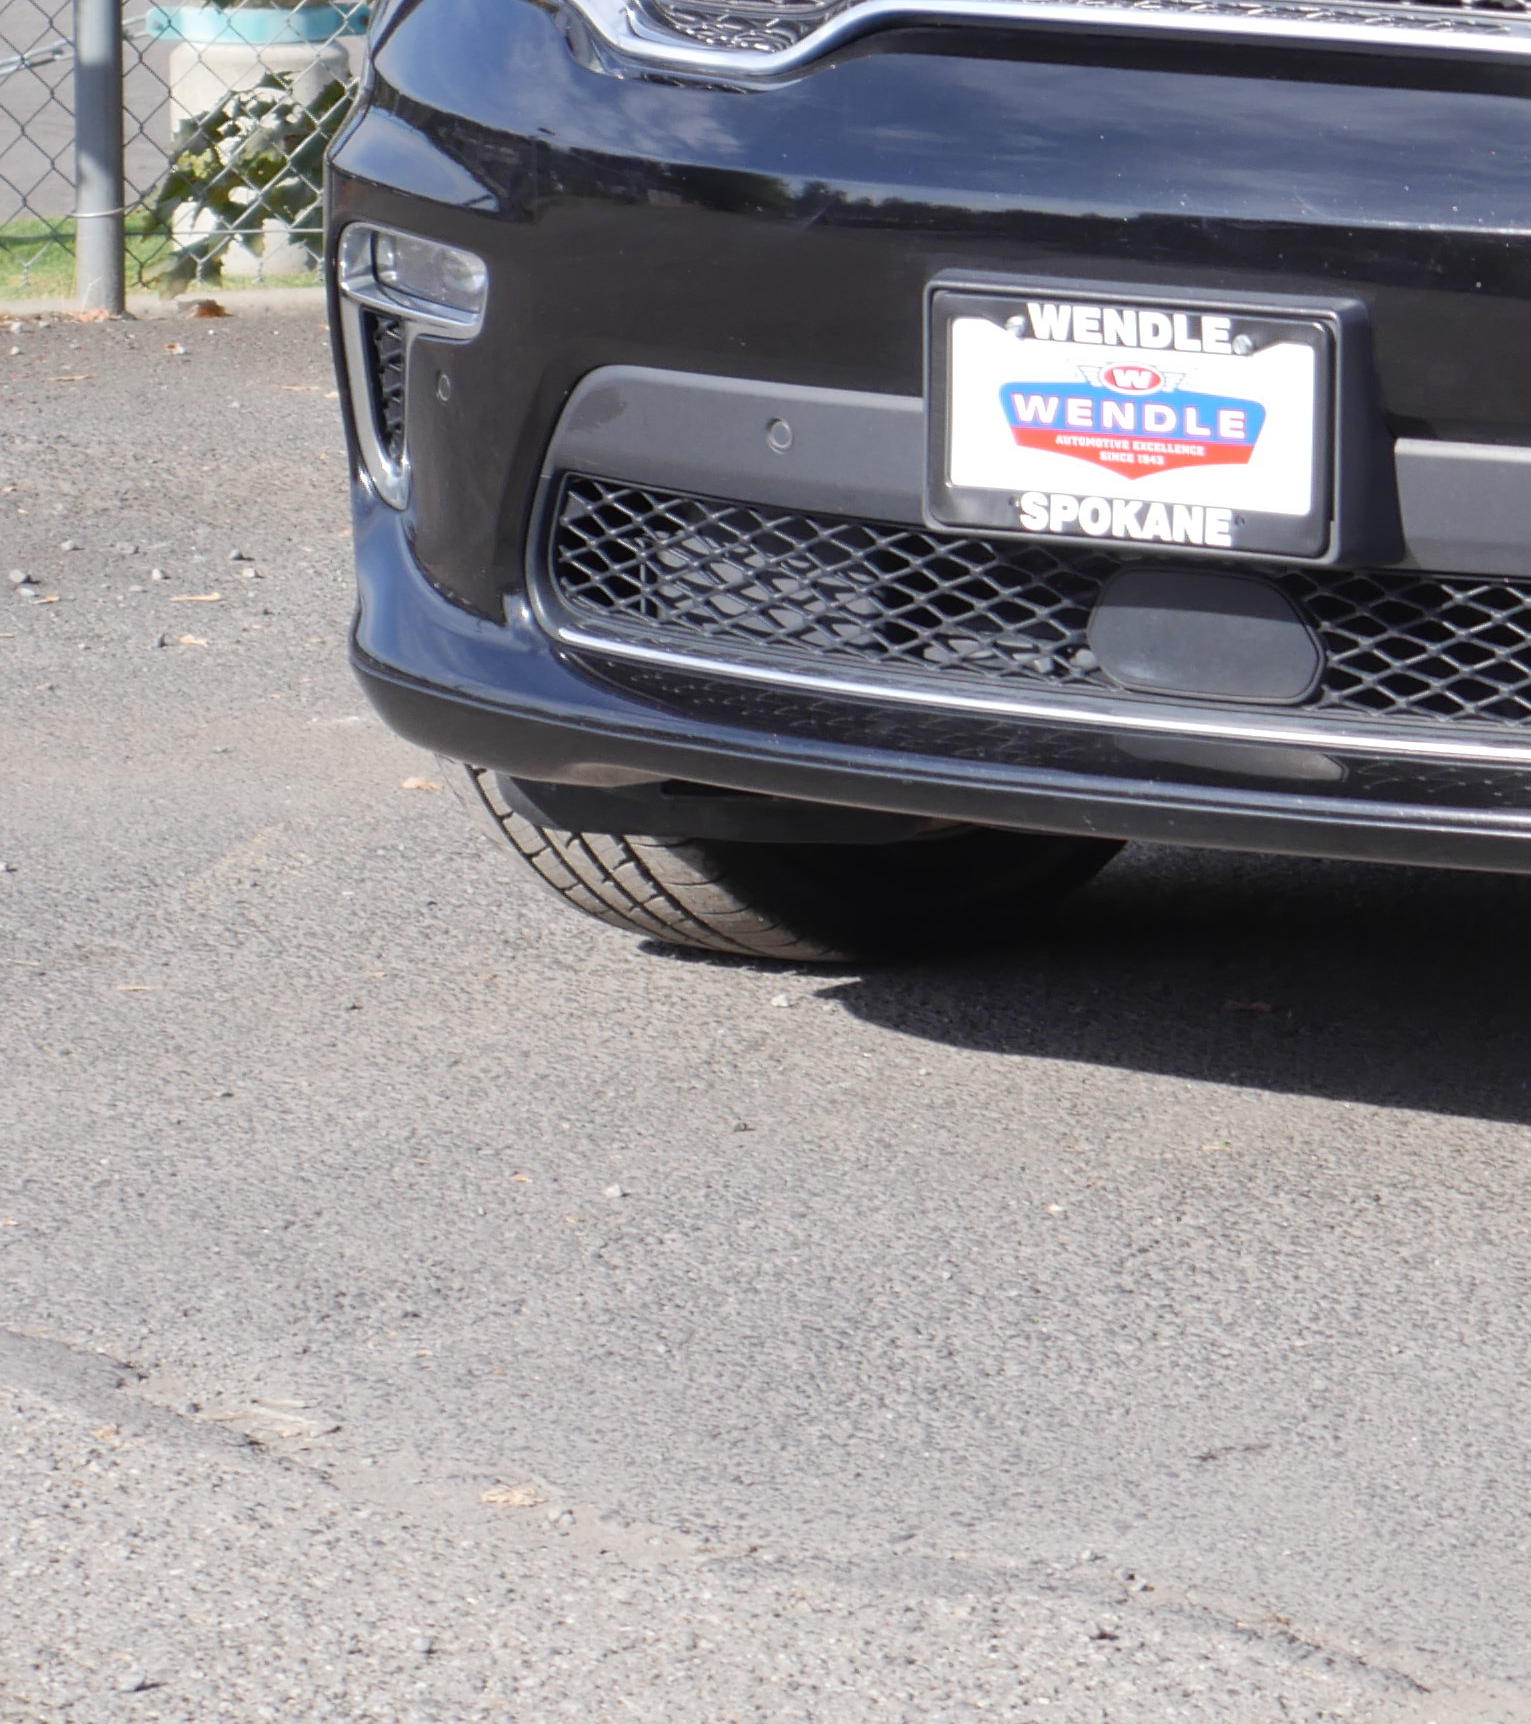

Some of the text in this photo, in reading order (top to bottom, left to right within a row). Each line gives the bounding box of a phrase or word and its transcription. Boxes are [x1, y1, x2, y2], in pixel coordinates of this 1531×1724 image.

[1026, 303, 1232, 354] WENDLE
[1012, 392, 1247, 439] WENDLE
[1055, 434, 1205, 456] AUTOMOTIVE EXCELLENCE
[1099, 451, 1135, 463] SINCE
[1020, 491, 1233, 548] SPOKANE
